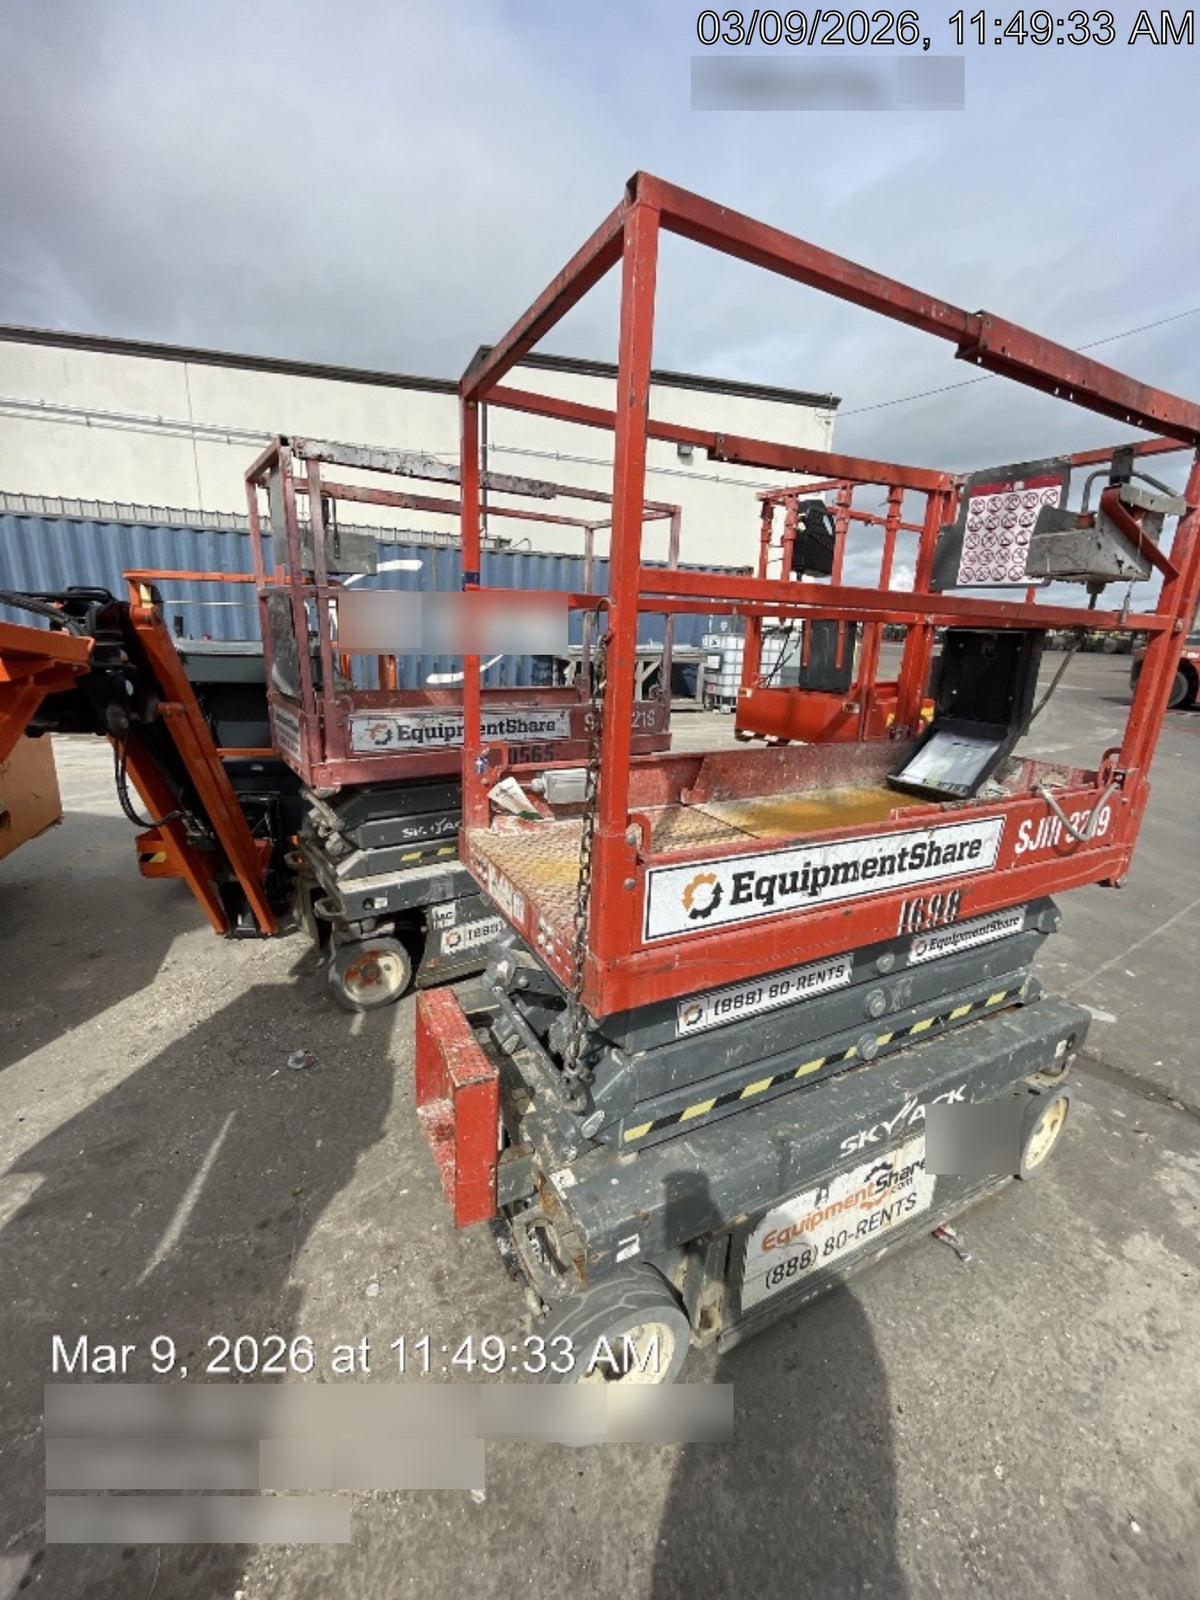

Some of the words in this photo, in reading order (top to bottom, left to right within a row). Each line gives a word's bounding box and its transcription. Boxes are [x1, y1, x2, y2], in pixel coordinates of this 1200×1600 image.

[730, 837, 983, 907] EquipmentShare
[896, 888, 962, 937] 1698
[928, 915, 1021, 952] EquipmentShare
[713, 994, 763, 1017] (888)
[767, 963, 846, 1000] 80-RENTS
[764, 1244, 819, 1290] (888)
[822, 1191, 918, 1258] 80-RENTS
